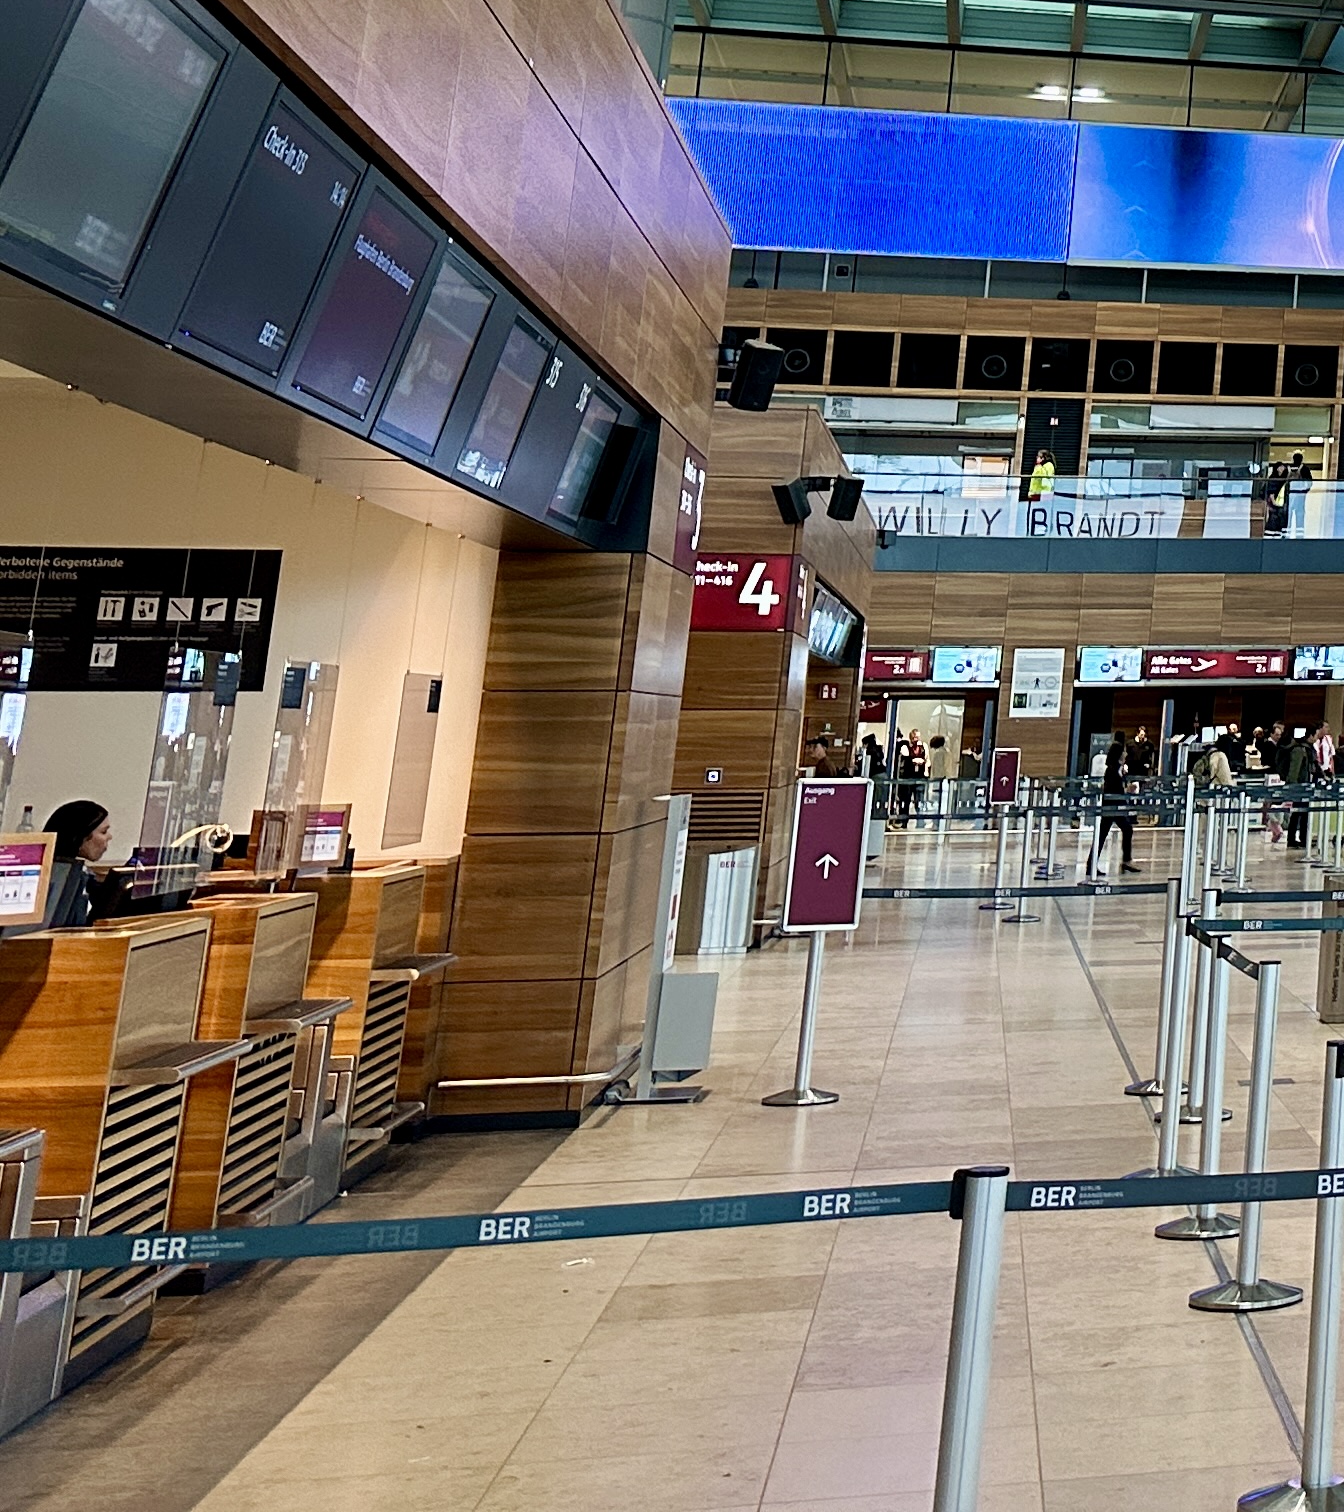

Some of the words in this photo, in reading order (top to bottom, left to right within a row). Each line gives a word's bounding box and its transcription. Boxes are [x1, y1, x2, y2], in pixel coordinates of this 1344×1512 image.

[878, 504, 1002, 536] WILLY
[1028, 507, 1166, 538] BRANDT
[52, 557, 124, 569] Gegenstände
[695, 560, 739, 573] heck-in
[0, 570, 45, 580] orbidden
[694, 575, 733, 586] 11–416
[738, 562, 780, 616] 4
[803, 1193, 851, 1218] BER
[1030, 1185, 1076, 1208] BER
[479, 1217, 531, 1240] BER
[131, 1238, 187, 1262] BER
